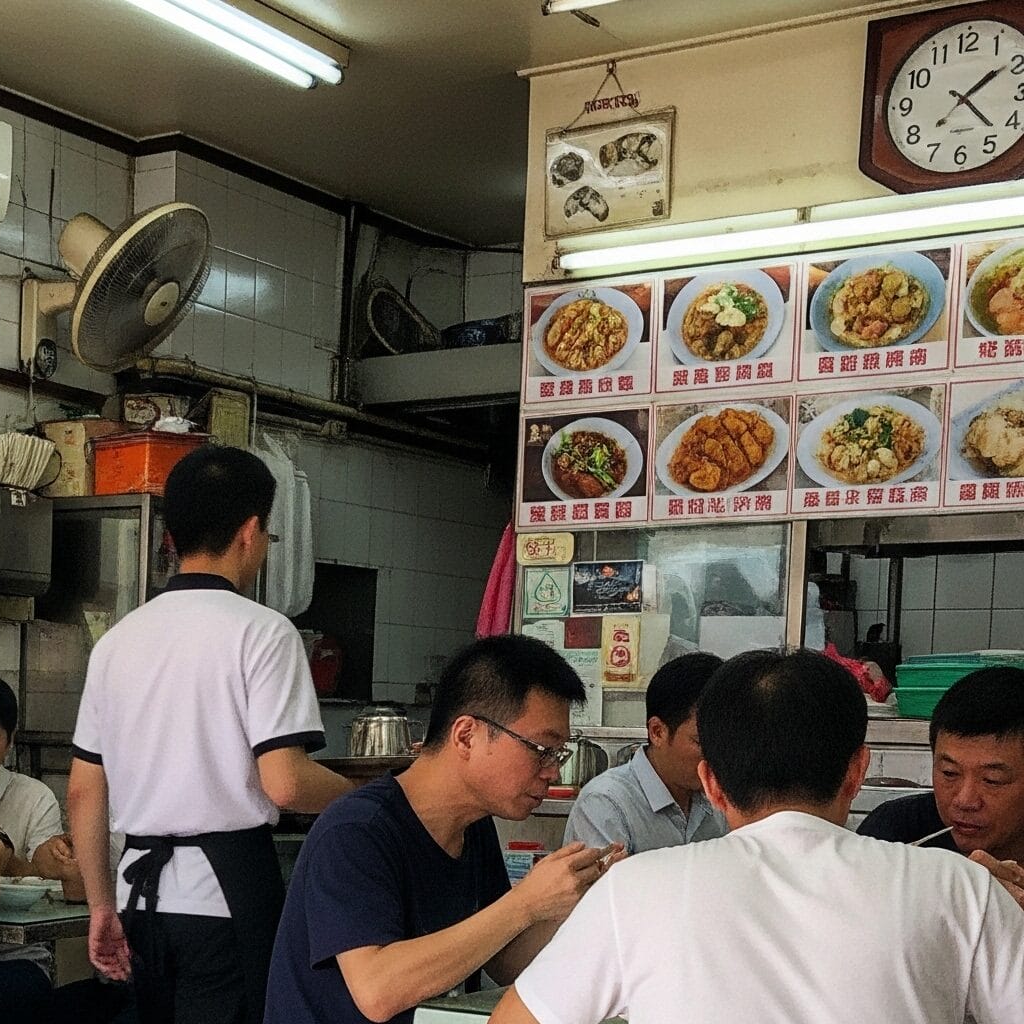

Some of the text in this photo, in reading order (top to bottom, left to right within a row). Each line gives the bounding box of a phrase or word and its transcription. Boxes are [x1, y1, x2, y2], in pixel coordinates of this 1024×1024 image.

[957, 32, 979, 54] 12
[993, 35, 999, 56] 1
[931, 44, 948, 65] 11
[1010, 54, 1024, 75] 2
[908, 68, 931, 90] 10
[899, 97, 913, 117] 9
[1004, 110, 1021, 130] 4
[906, 125, 920, 145] 8
[983, 134, 998, 154] 5
[927, 143, 941, 162] 7
[953, 145, 967, 165] 6
